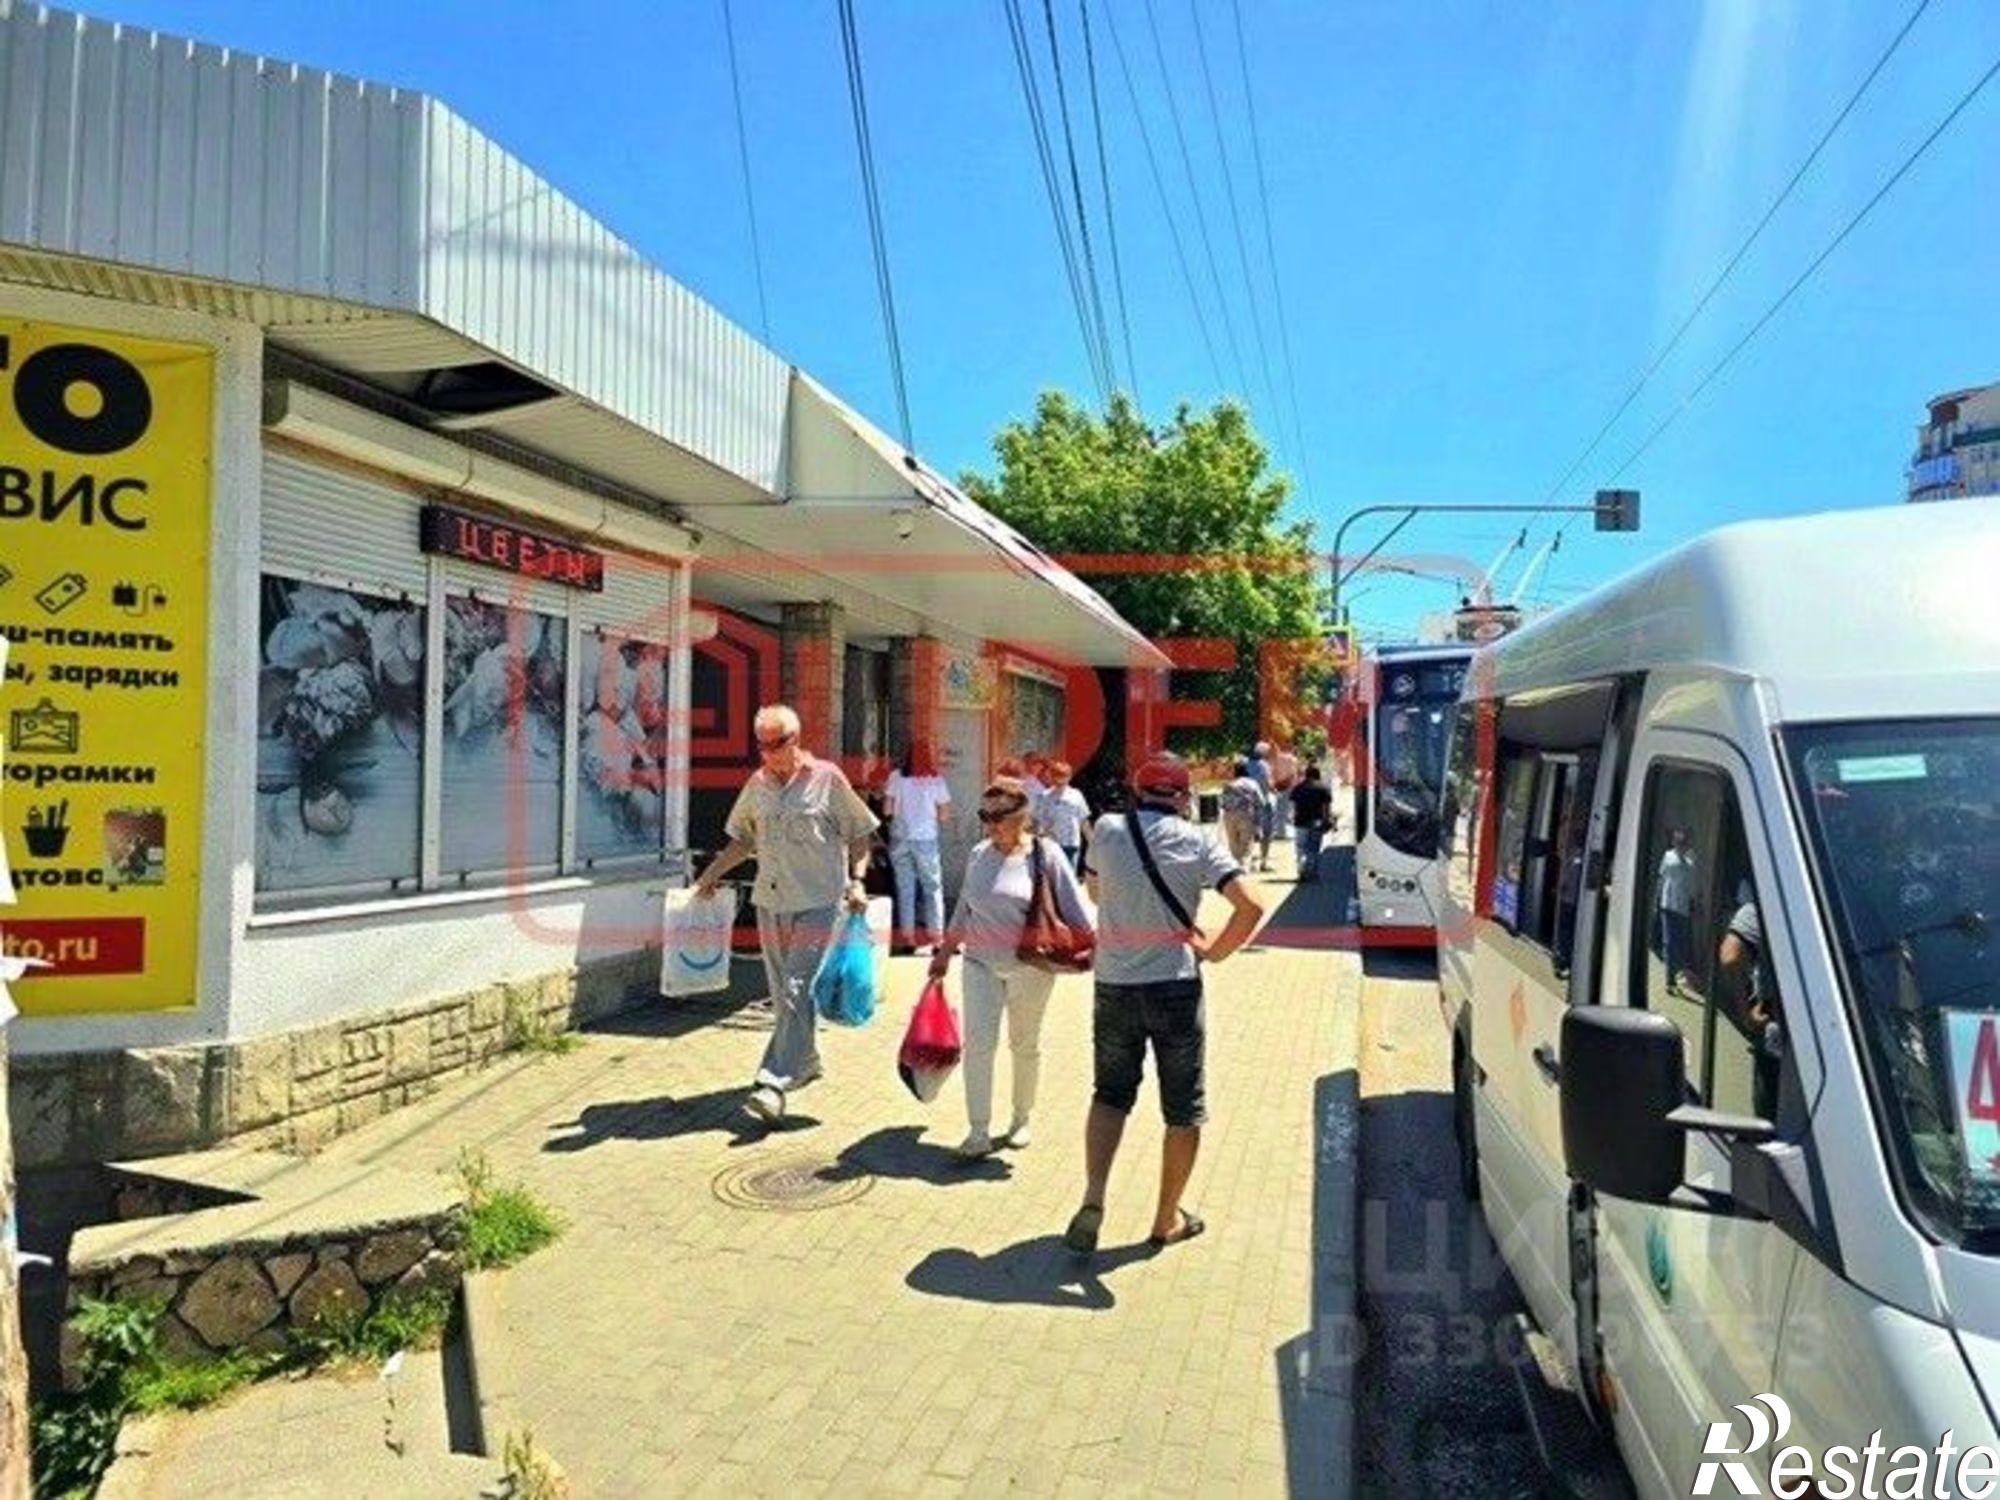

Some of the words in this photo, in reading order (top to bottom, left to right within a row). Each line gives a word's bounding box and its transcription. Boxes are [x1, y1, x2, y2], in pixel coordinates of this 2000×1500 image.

[0, 334, 152, 455] О
[0, 465, 148, 530] ВИС
[48, 665, 179, 690] зарядки
[11, 868, 118, 892] това
